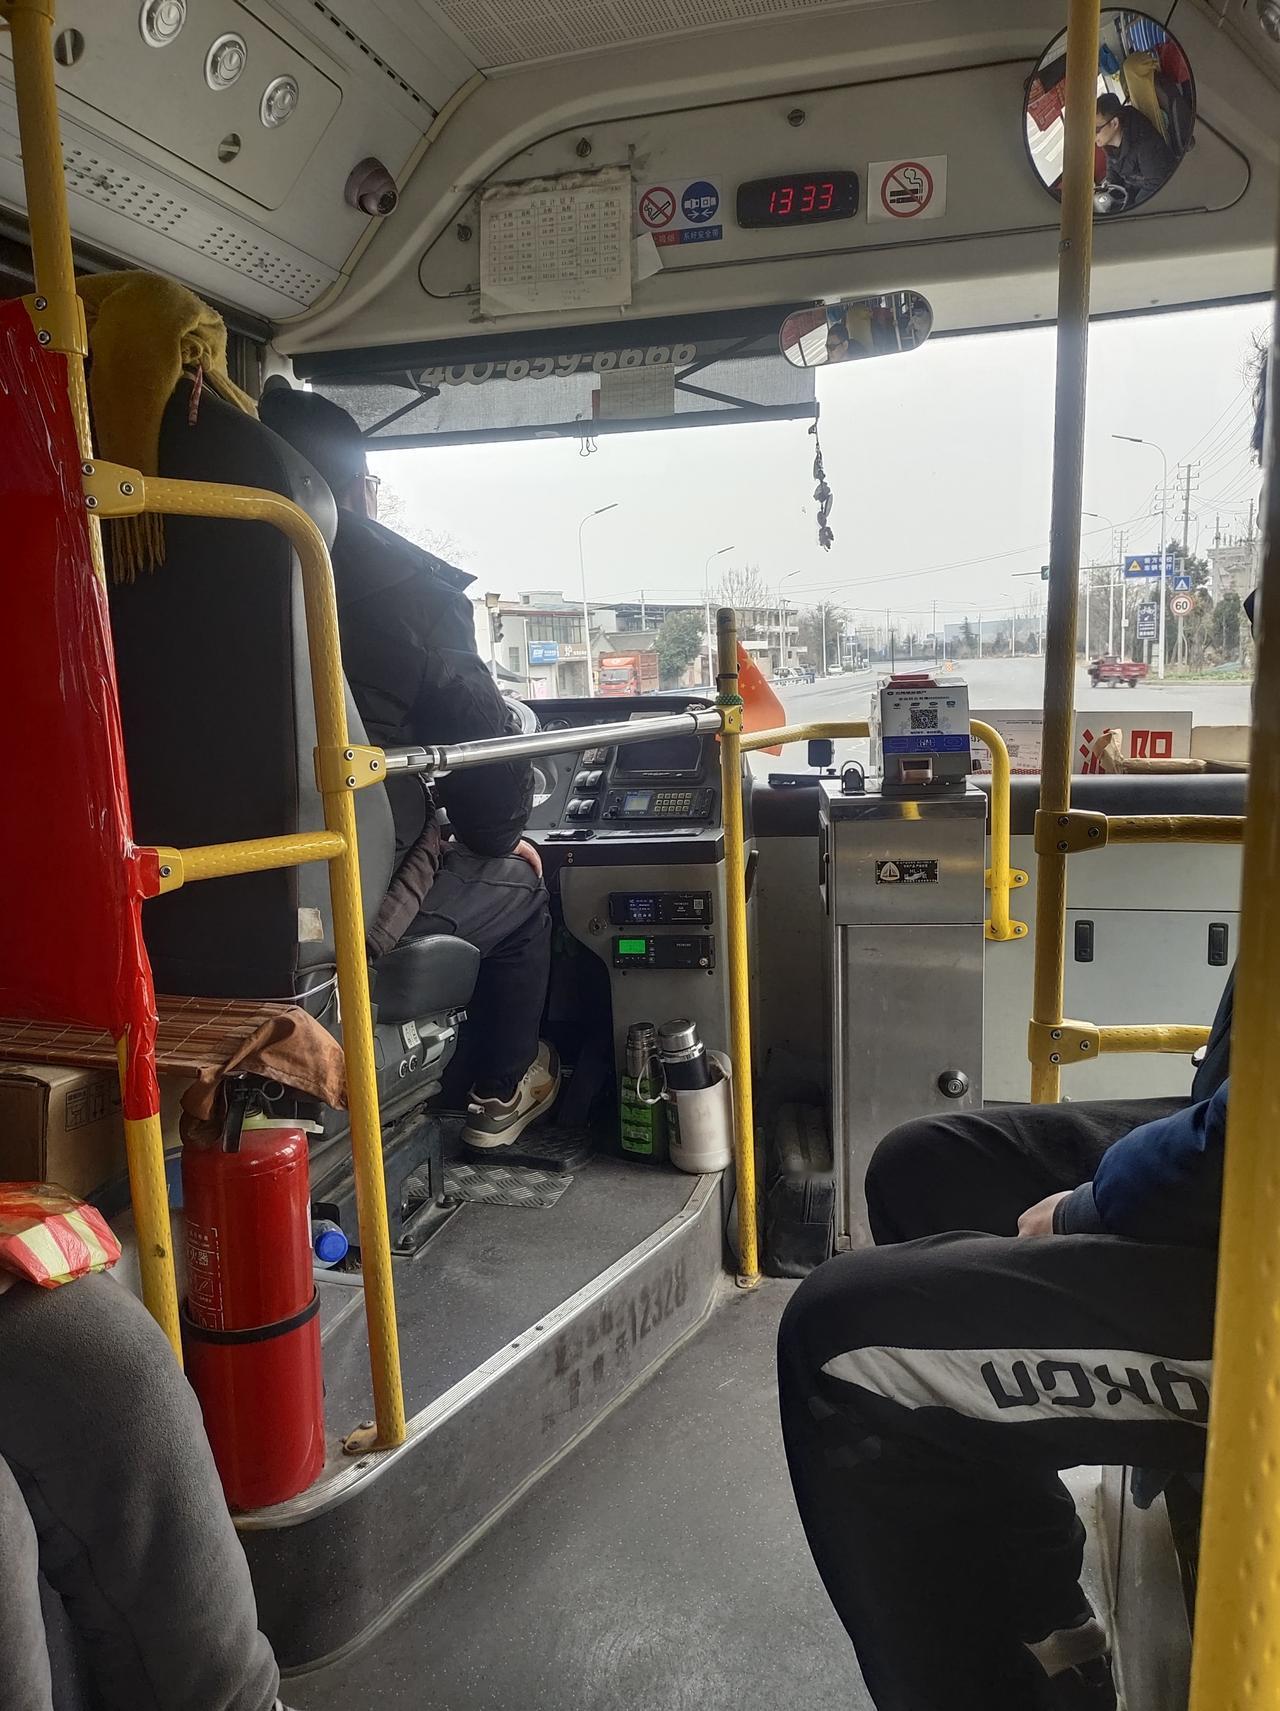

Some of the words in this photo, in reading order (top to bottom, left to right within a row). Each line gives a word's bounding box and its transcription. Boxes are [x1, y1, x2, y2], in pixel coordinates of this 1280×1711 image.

[682, 230, 720, 242] 系好安全带
[1175, 601, 1188, 611] 60
